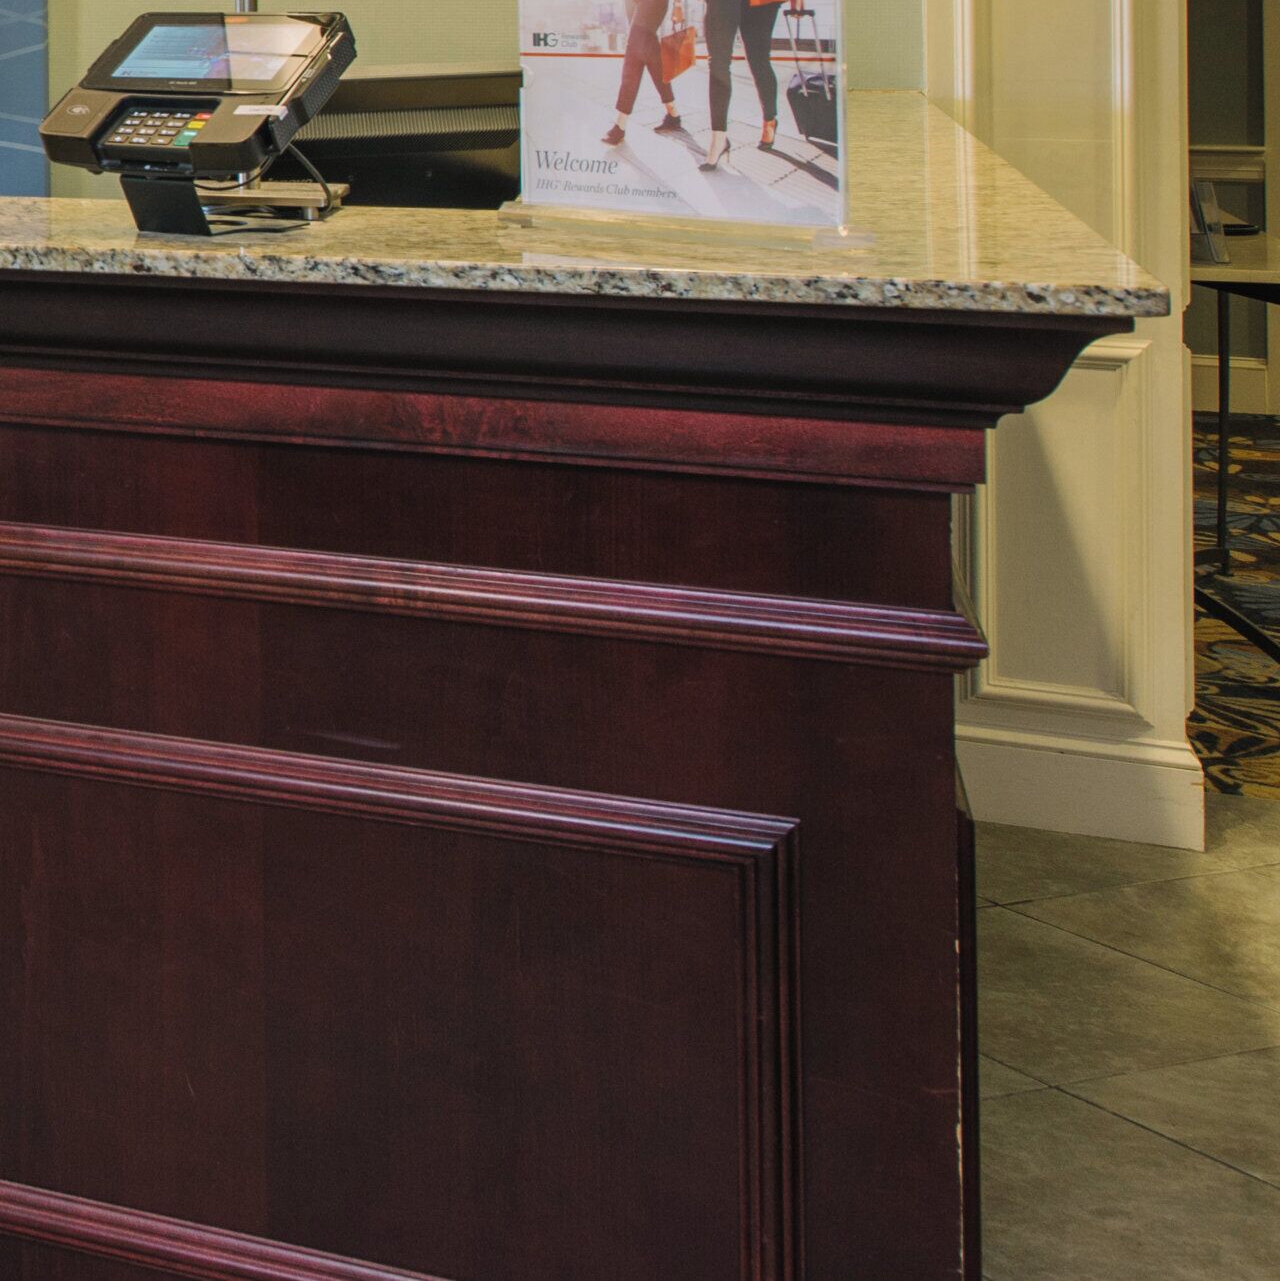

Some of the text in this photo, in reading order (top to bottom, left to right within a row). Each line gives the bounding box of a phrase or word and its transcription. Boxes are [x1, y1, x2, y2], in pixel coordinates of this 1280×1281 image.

[532, 31, 559, 48] IHG
[535, 150, 618, 175] Welcome
[562, 180, 605, 195] Rewards
[606, 183, 631, 196] Club
